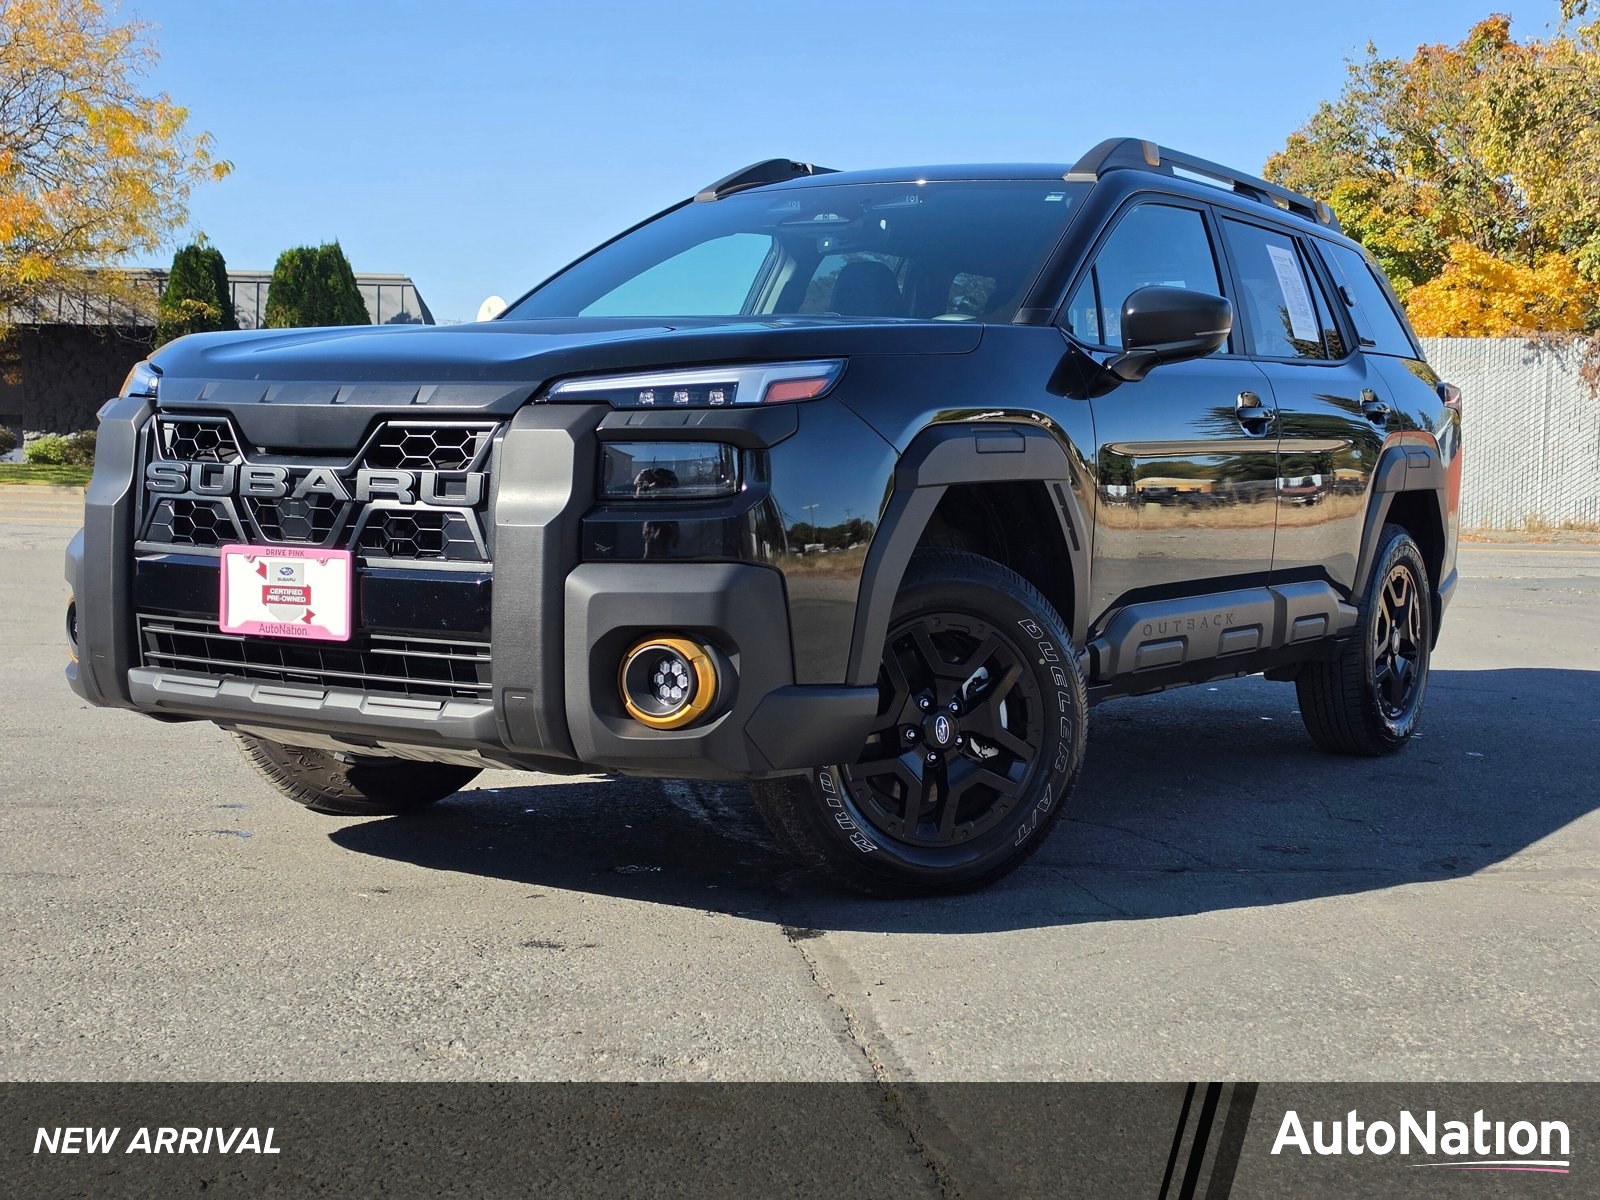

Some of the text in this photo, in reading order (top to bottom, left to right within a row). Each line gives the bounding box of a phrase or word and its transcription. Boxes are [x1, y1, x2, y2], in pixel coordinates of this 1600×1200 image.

[145, 461, 486, 507] SUBARU
[265, 548, 305, 557] DRIVE PINK
[269, 587, 303, 596] CERTIFIED
[266, 594, 306, 603] PRE-OWNED
[258, 623, 308, 636] AutoNation
[1142, 612, 1234, 636] OUTBACK
[1014, 617, 1073, 847] DUELER A/T
